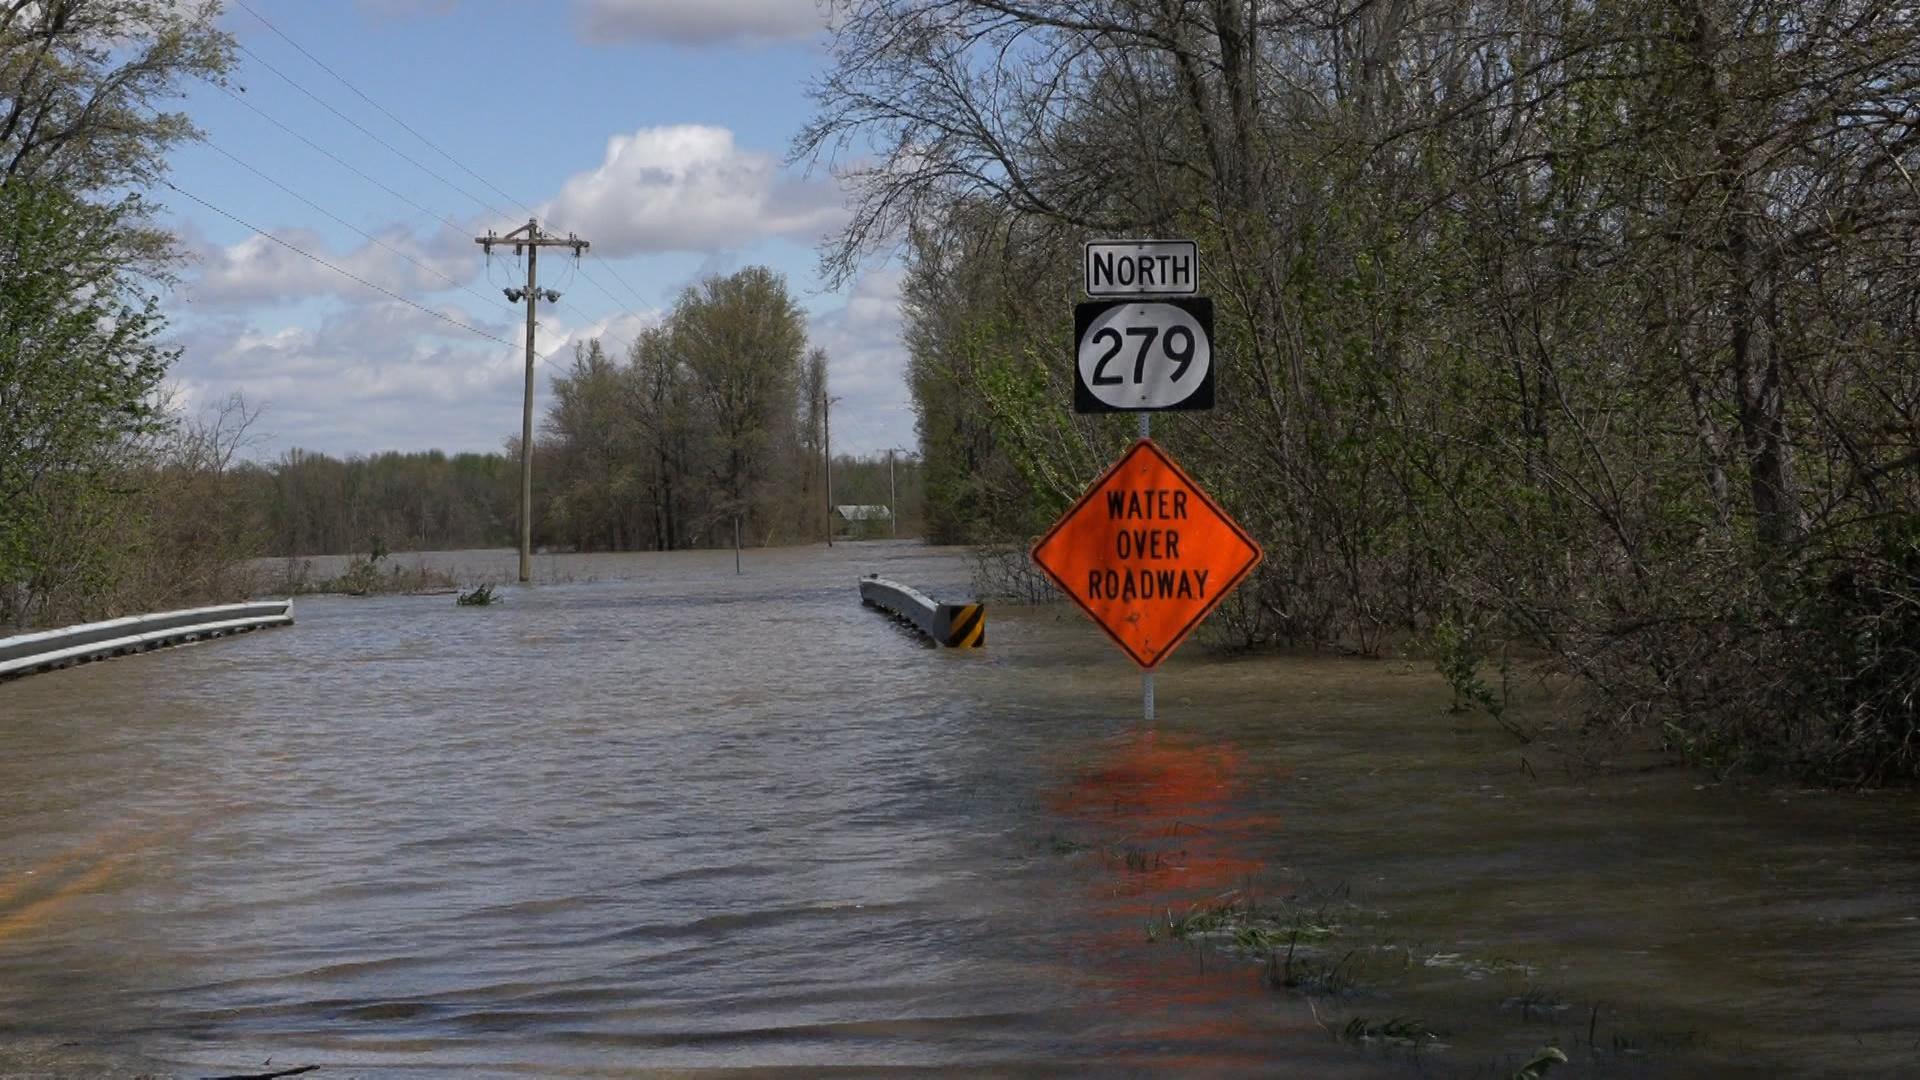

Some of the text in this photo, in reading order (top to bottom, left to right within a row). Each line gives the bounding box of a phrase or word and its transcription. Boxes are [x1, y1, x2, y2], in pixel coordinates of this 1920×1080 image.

[1093, 252, 1190, 286] NORTH
[1092, 325, 1196, 386] 279
[1107, 490, 1188, 520] WATER
[1116, 529, 1180, 560] OVER
[1088, 569, 1209, 600] ROADWAY
